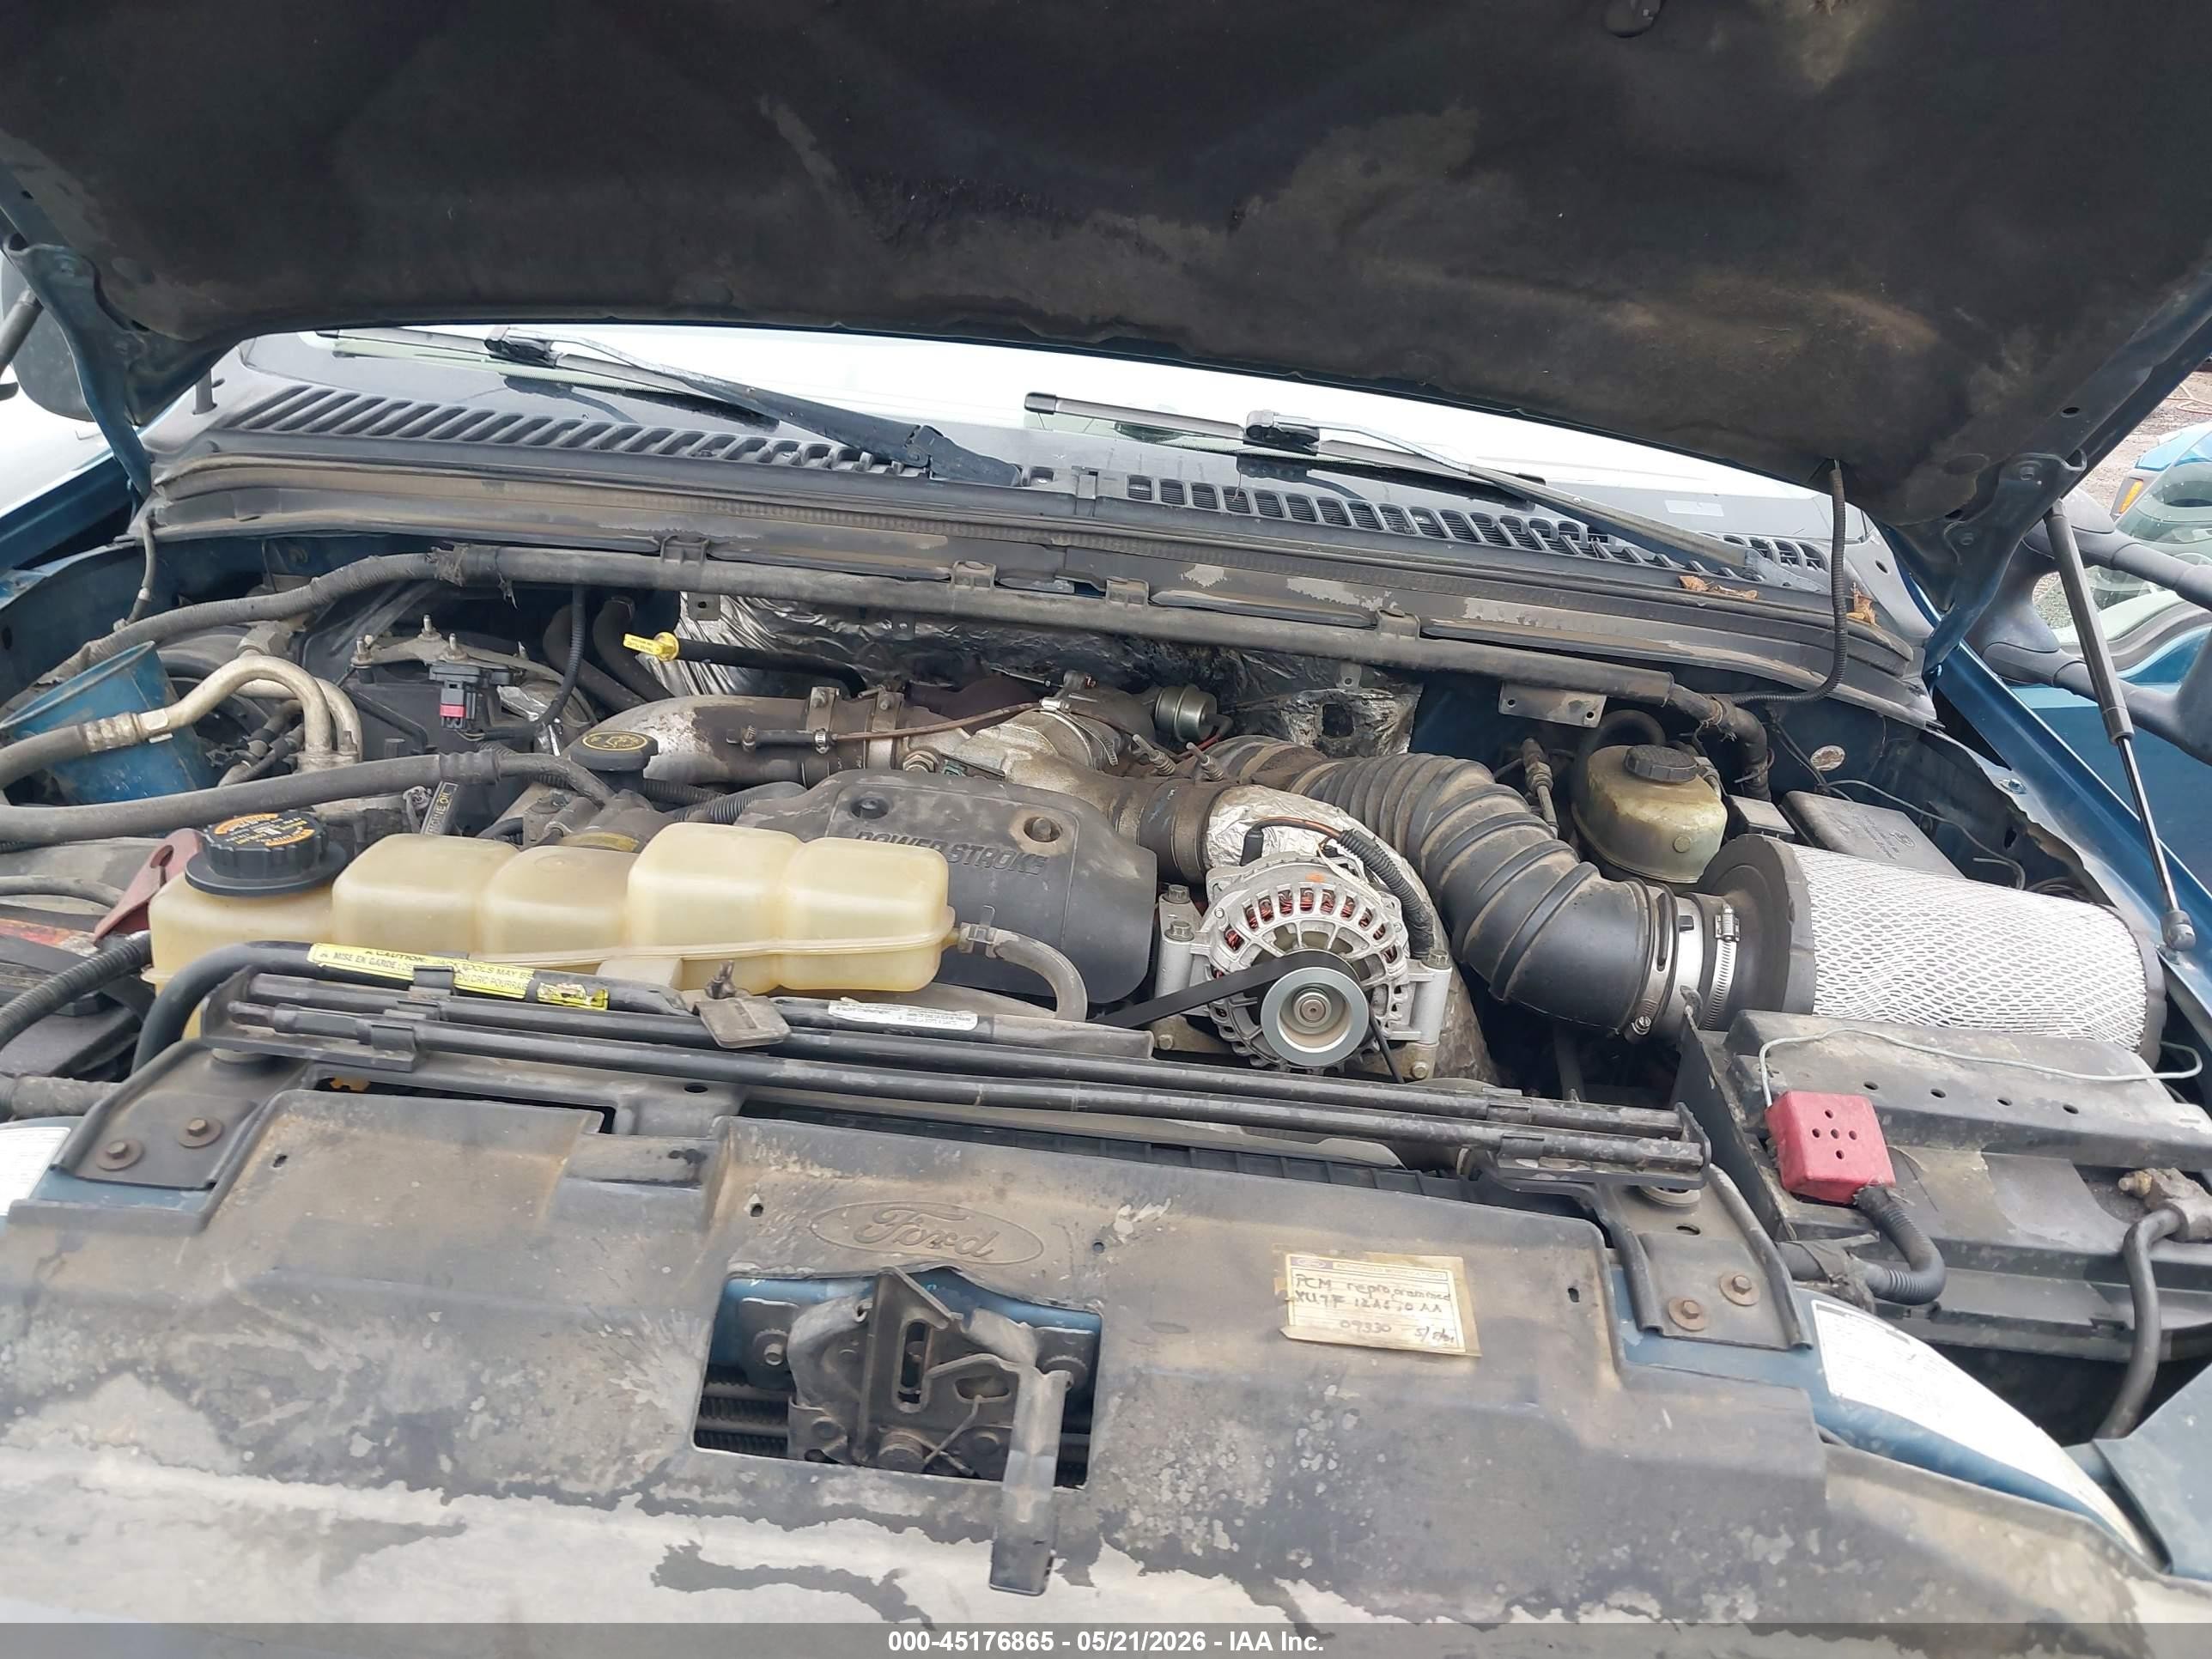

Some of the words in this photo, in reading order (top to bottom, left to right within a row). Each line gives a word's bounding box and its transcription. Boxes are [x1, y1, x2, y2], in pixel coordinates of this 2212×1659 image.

[947, 843, 1048, 876] STROKE
[333, 951, 354, 962] MISE
[355, 955, 367, 963] EN
[496, 968, 518, 978] MAY
[853, 1206, 1000, 1258] Ford
[1295, 1273, 1332, 1290] PCM
